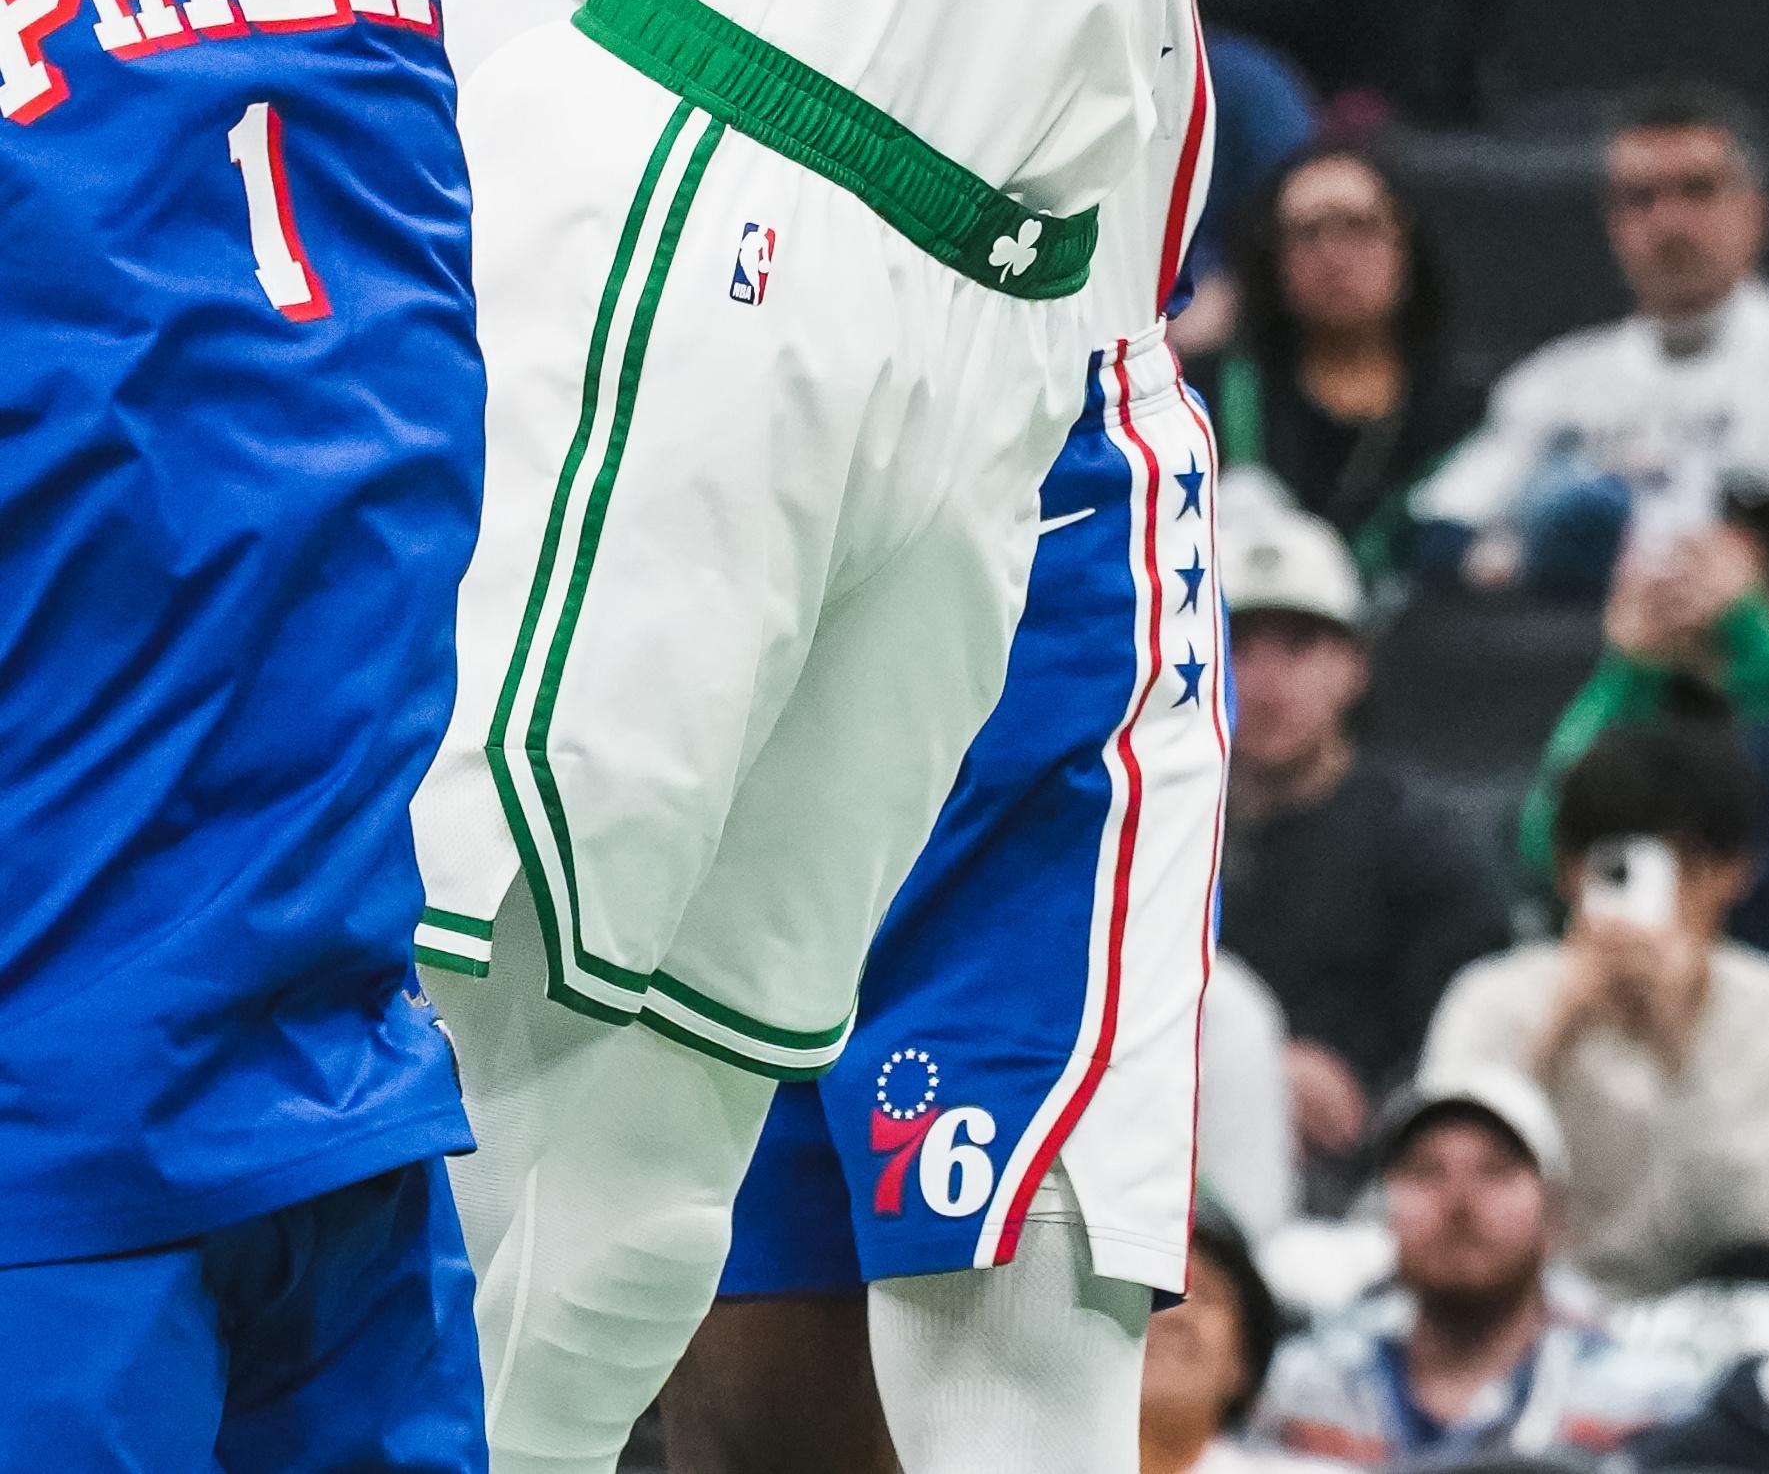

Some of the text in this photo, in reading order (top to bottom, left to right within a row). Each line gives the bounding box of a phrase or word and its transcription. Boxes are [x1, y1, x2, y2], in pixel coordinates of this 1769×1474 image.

[228, 101, 332, 322] 1
[732, 281, 753, 301] NBA
[870, 1106, 997, 1218] 76
